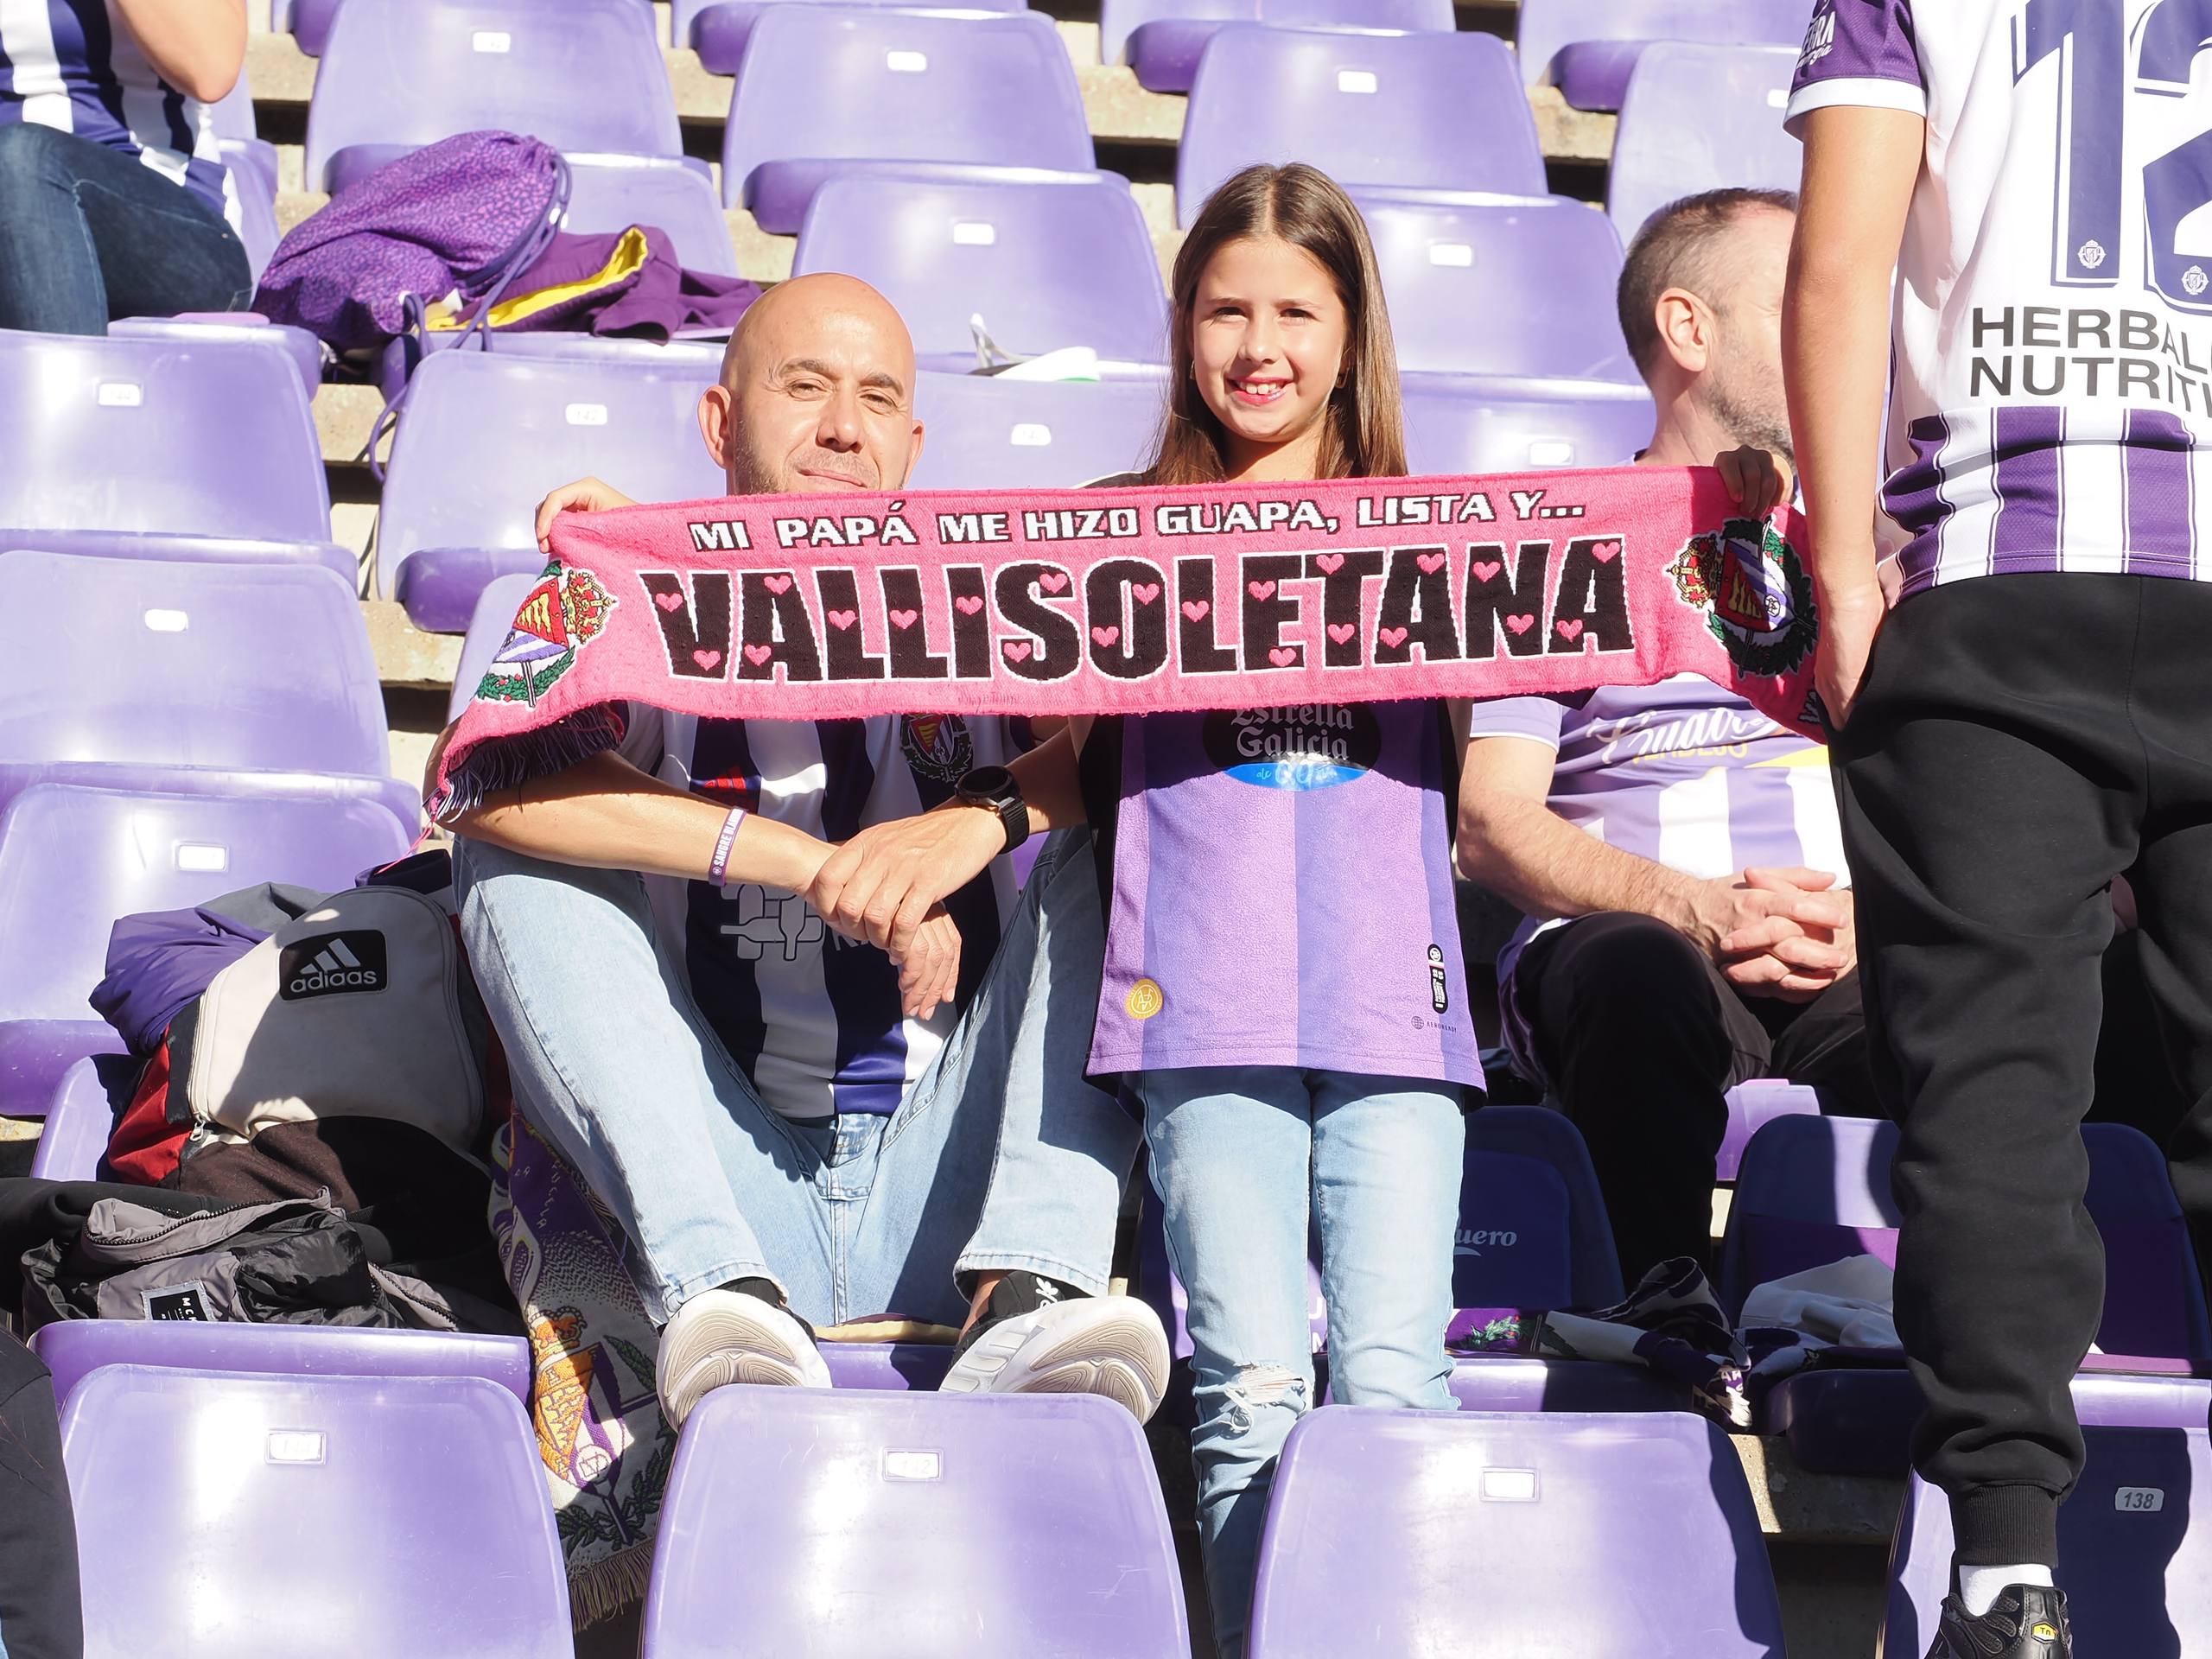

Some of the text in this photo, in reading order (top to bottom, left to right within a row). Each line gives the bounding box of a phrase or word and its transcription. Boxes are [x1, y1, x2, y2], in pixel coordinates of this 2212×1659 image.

[1973, 306, 2212, 375] HERBAL
[689, 490, 1586, 550] MI PAPÁ ME HIZO GUAPA, LISTA Y...
[638, 534, 1635, 682] VALLISOLETANA
[1236, 727, 1350, 760] Galicia
[713, 834, 733, 868] SANGRE
[2124, 1491, 2154, 1509] 138
[2040, 1627, 2050, 1636] Tn
